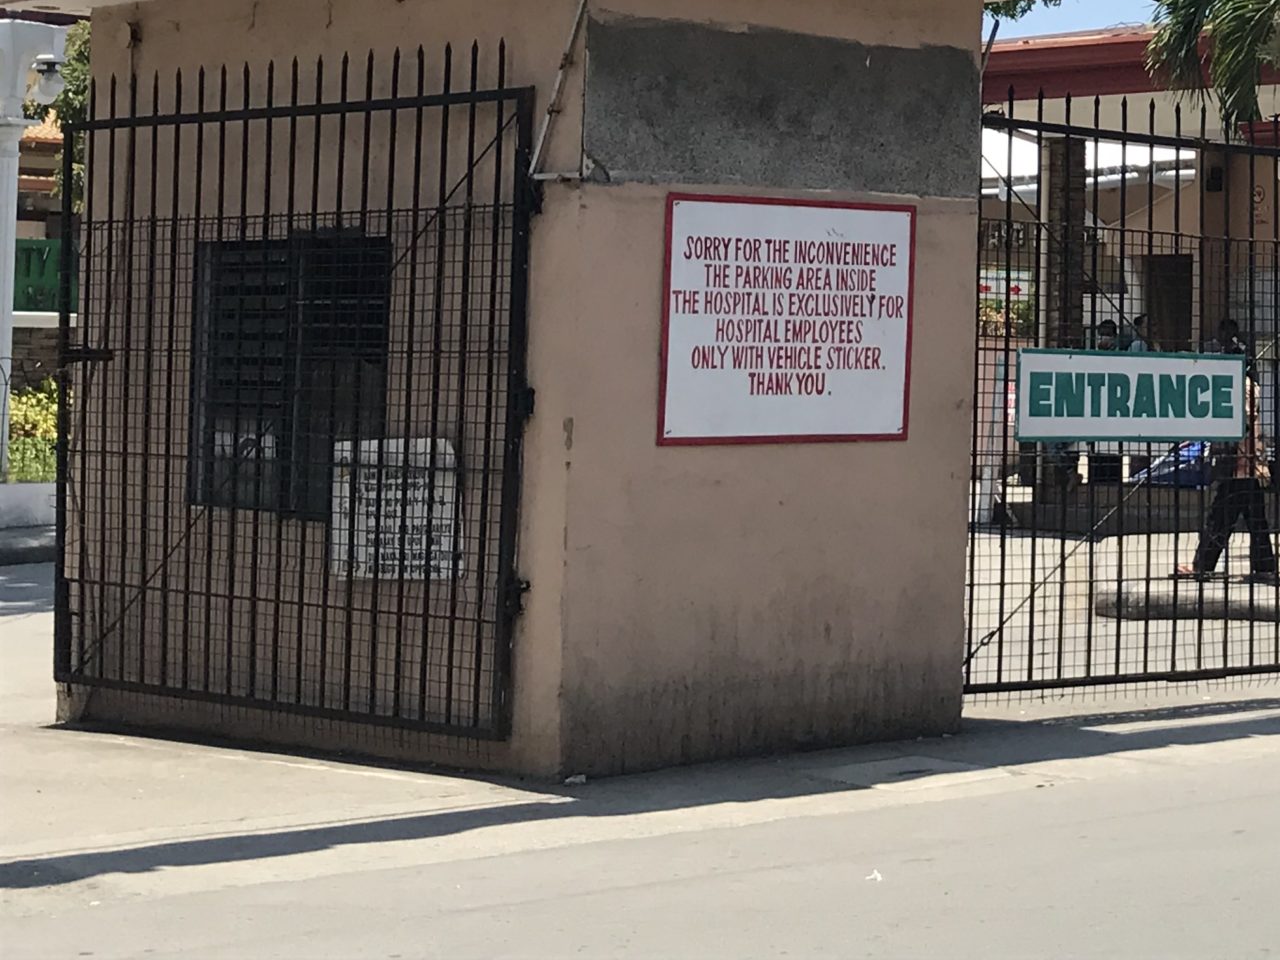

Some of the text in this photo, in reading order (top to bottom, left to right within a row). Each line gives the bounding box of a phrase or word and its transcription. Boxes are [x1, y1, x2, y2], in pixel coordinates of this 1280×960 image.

[683, 236, 897, 267] SORRY FOR THE INCONVENIENCE
[704, 264, 877, 292] THE PARKING AREA INSIDE
[672, 290, 904, 320] THE HOSPITAL IS EXCLUSIVELY FOR
[715, 319, 863, 344] HOSPITAL EMPLOYEES
[691, 345, 886, 371] ONLY WITH VEHICLE STICKER.
[748, 373, 793, 396] THANK
[1029, 371, 1234, 419] ENTRANCE
